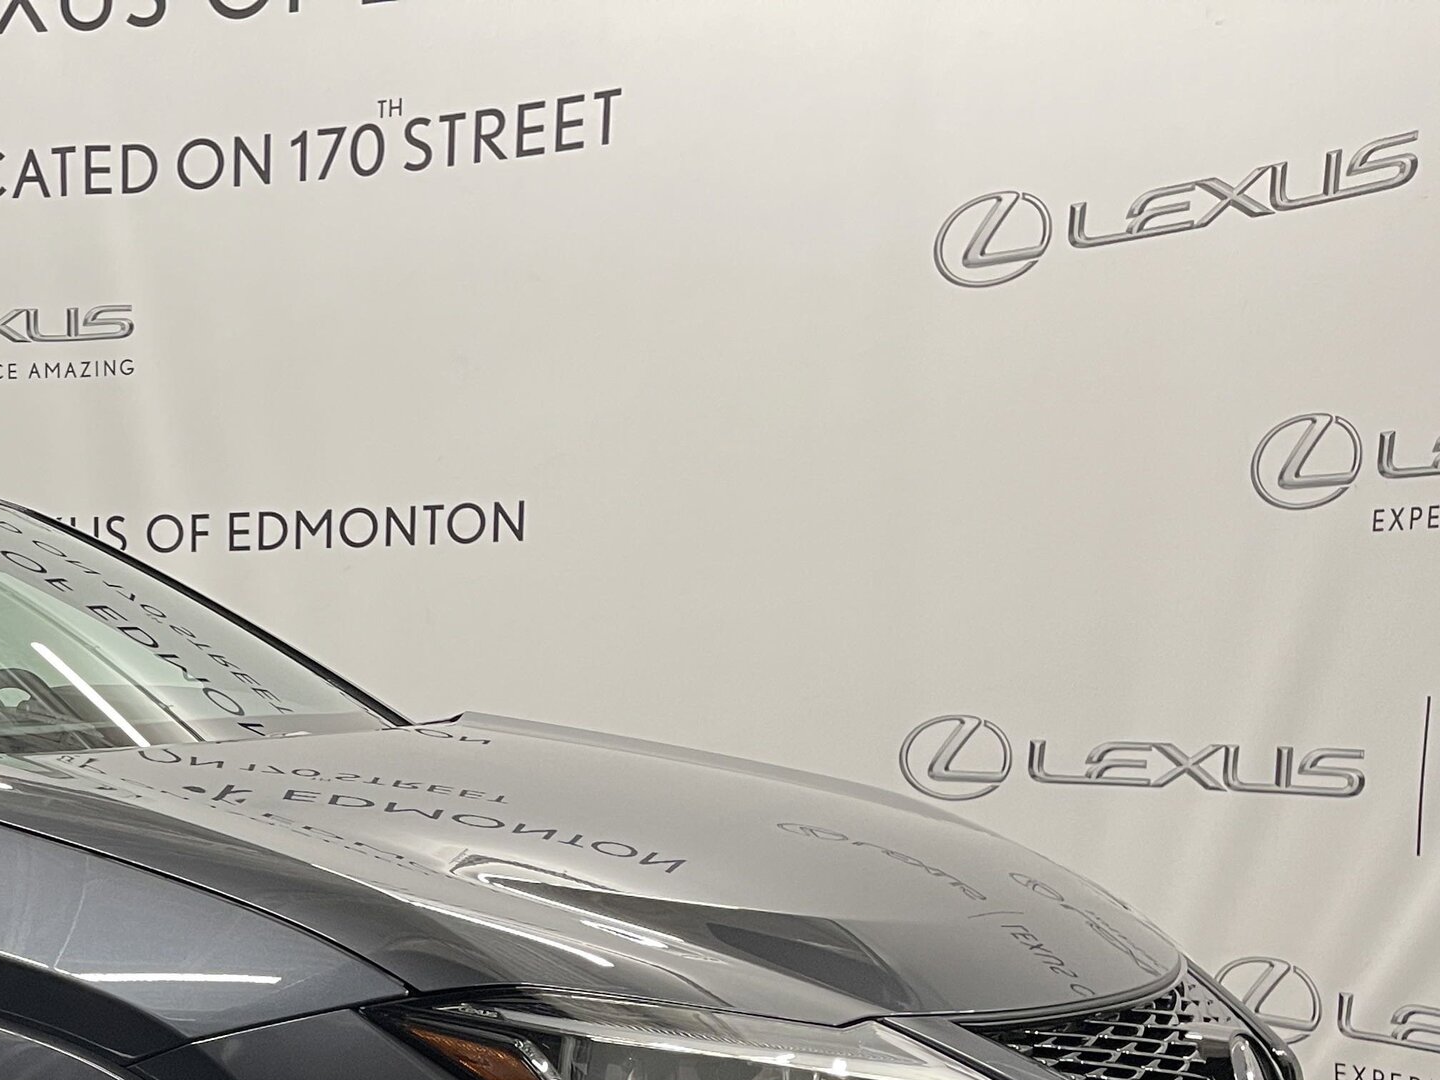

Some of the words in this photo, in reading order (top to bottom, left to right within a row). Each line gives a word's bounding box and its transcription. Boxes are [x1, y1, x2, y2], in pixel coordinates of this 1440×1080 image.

[177, 133, 271, 190] ON
[403, 88, 622, 171] STREET
[1068, 130, 1419, 248] LEXUS
[28, 359, 134, 379] AMAZING
[147, 514, 210, 553] OF
[229, 500, 525, 551] EDMONTON
[1028, 739, 1365, 798] LEXUS
